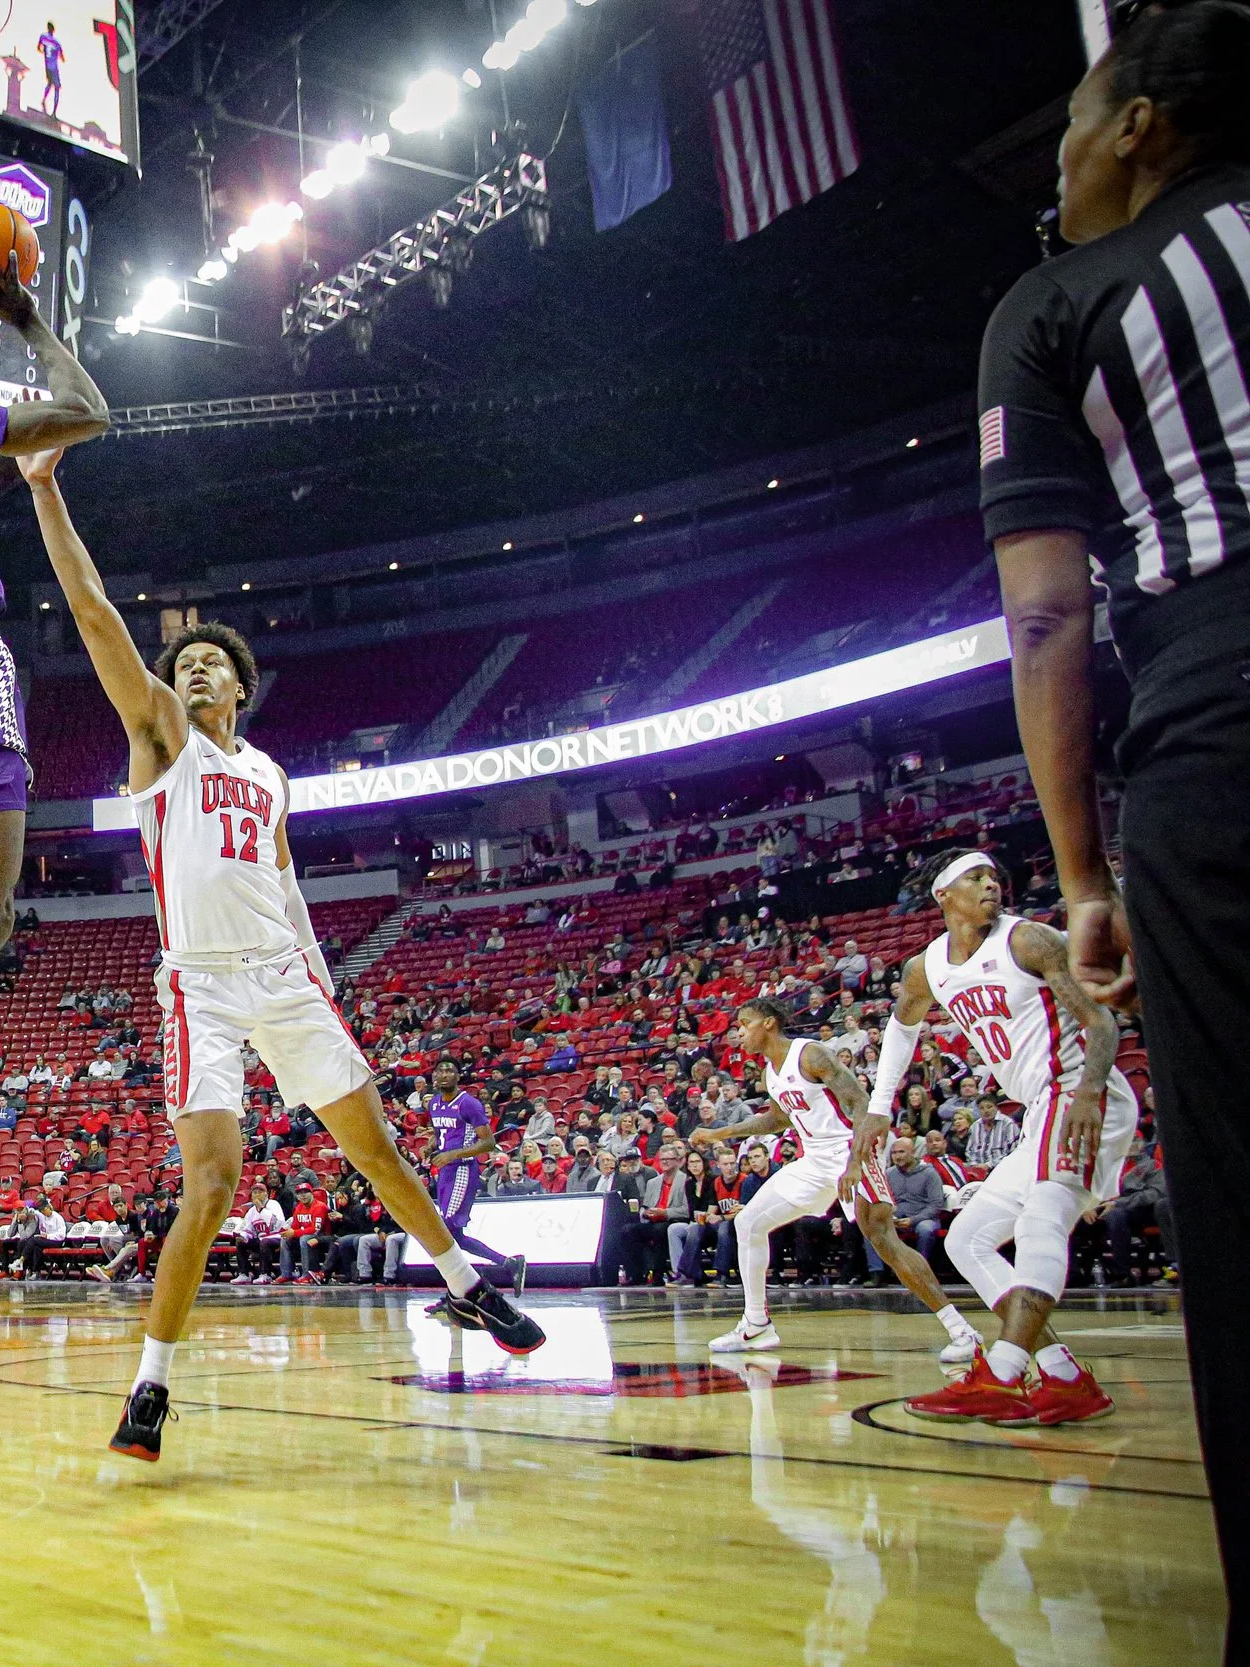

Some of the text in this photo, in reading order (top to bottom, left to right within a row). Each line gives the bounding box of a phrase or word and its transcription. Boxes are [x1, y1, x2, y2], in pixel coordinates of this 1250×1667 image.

[26, 366, 37, 384] 0
[310, 695, 770, 809] NEVADA DONOR NETWORK
[201, 772, 273, 827] UNLV
[220, 813, 258, 864] 12
[948, 985, 1012, 1034] UNLV
[974, 1021, 1012, 1064] 10
